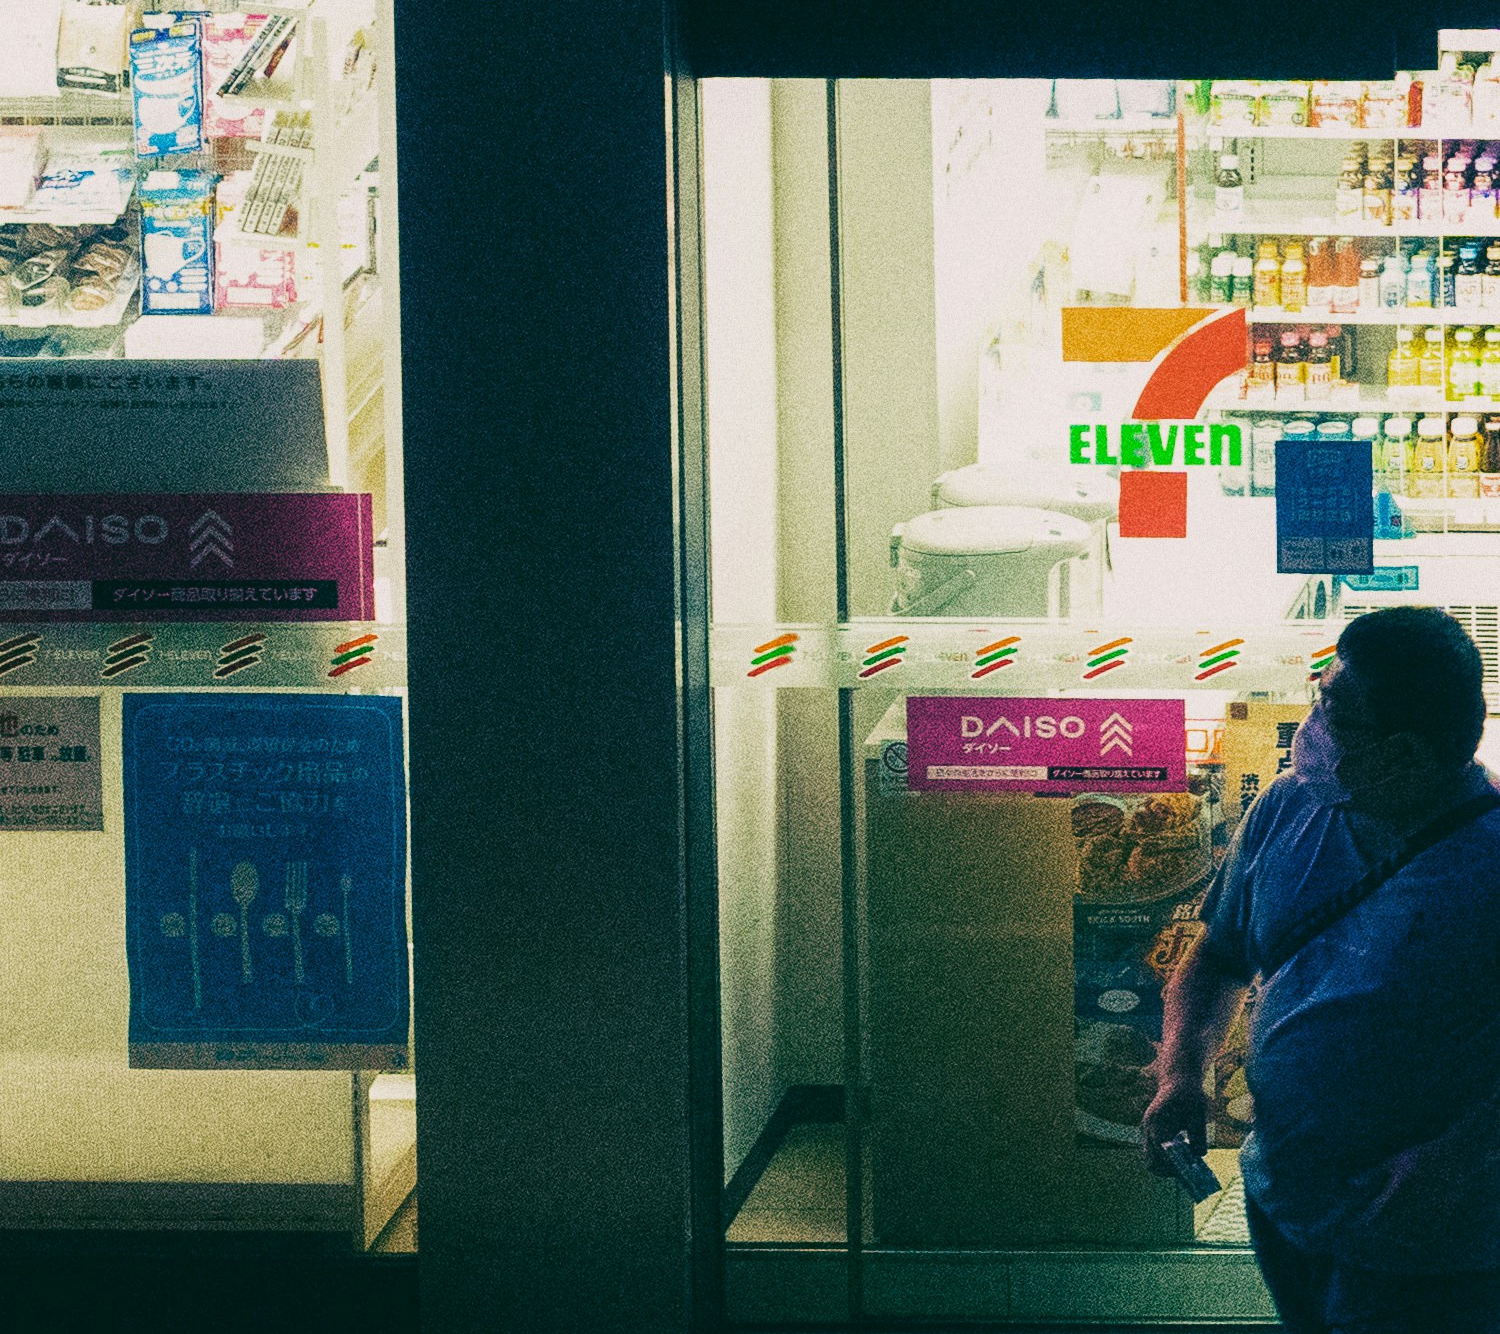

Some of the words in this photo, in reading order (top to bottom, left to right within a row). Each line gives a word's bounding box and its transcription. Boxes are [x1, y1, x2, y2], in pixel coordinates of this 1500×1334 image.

[1069, 424, 1242, 466] ELEVEn
[1, 514, 170, 546] DAISO
[2, 552, 67, 566] ダイソー
[961, 715, 1086, 738] DAISO
[962, 742, 1012, 754] ダイソー
